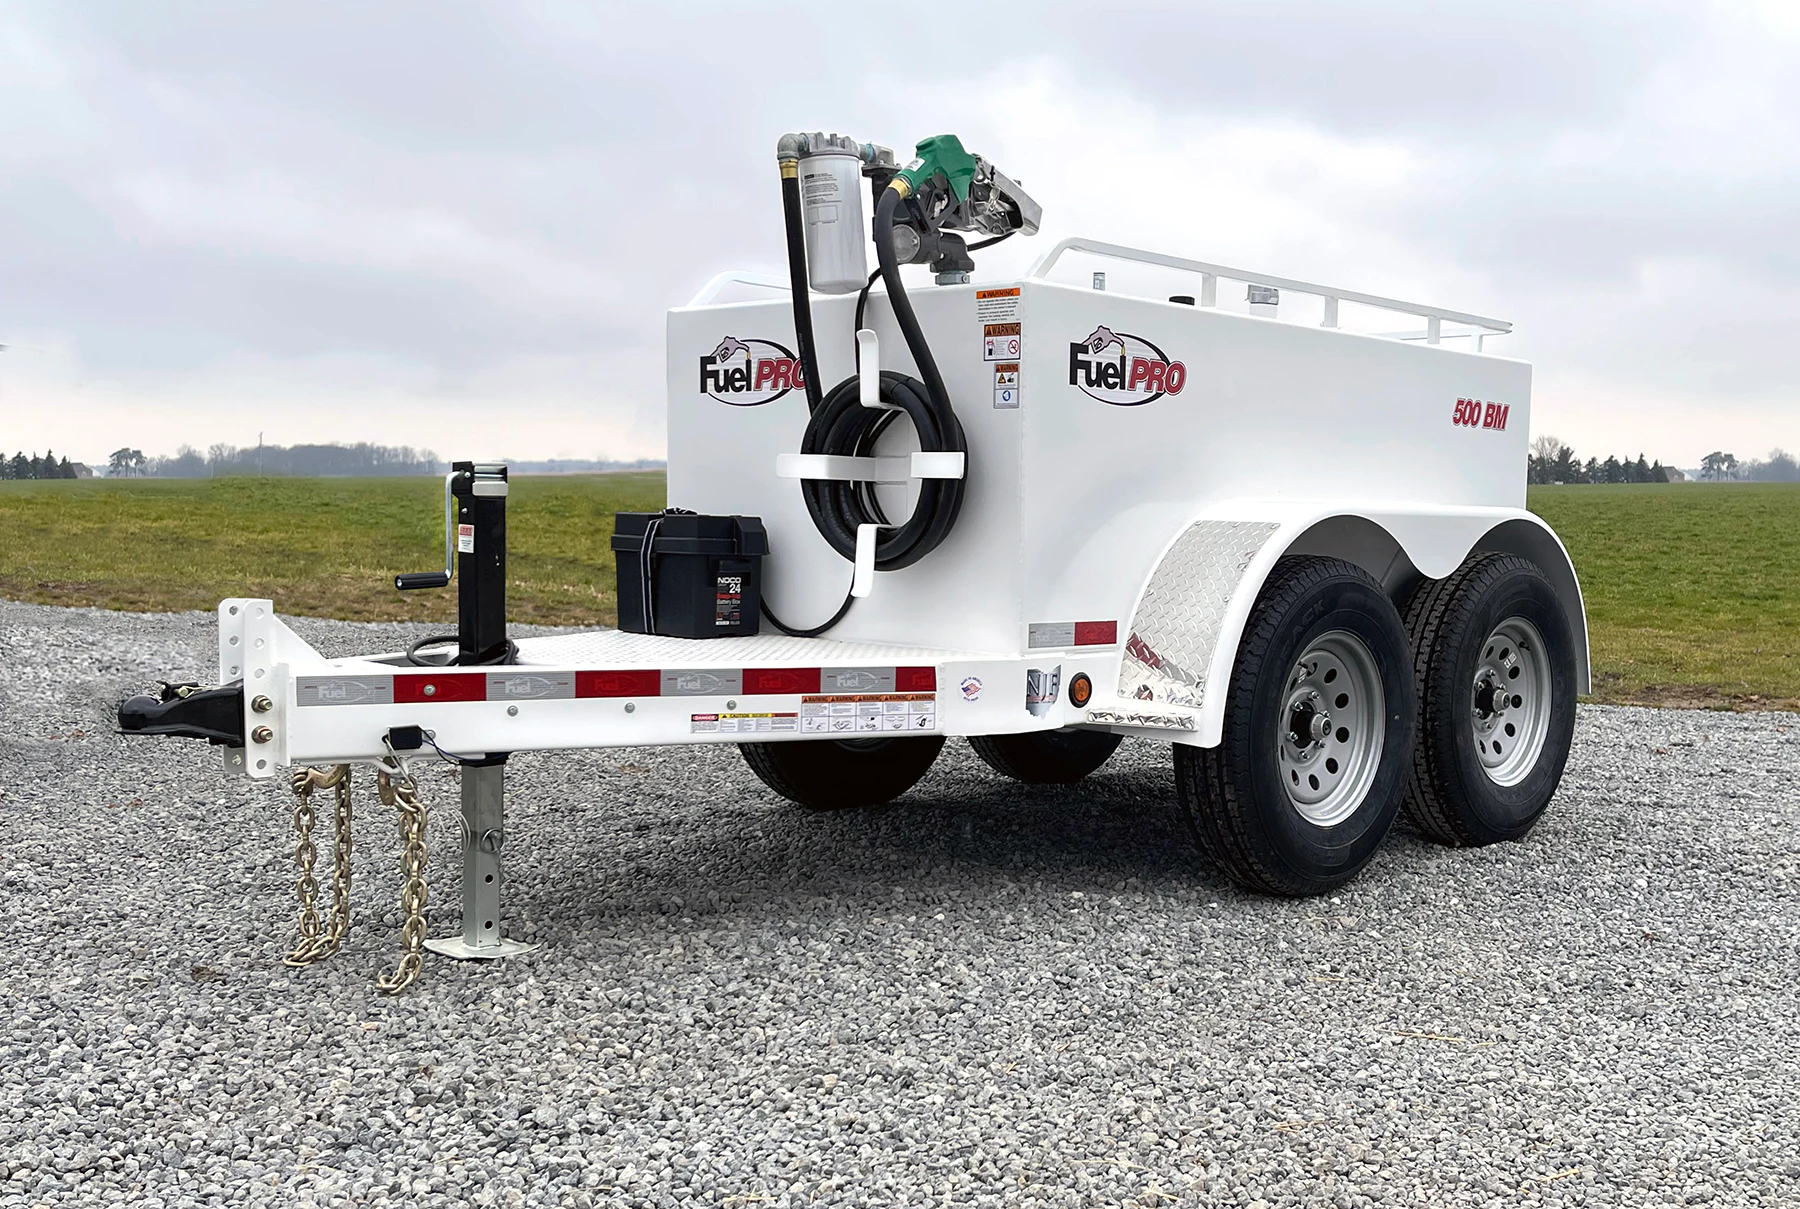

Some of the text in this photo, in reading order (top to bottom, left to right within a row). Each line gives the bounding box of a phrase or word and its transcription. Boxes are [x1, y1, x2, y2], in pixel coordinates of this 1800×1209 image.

[987, 289, 1014, 298] WARNING
[992, 325, 1019, 335] WARNING
[700, 356, 752, 393] Fuel
[1069, 342, 1187, 396] Fuel PRO
[1452, 397, 1510, 431] 500 BM
[729, 584, 741, 594] 24
[505, 680, 531, 694] Fuel
[677, 676, 701, 690] Fuel
[837, 675, 859, 687] Fuel
[318, 685, 346, 699] Fuel
